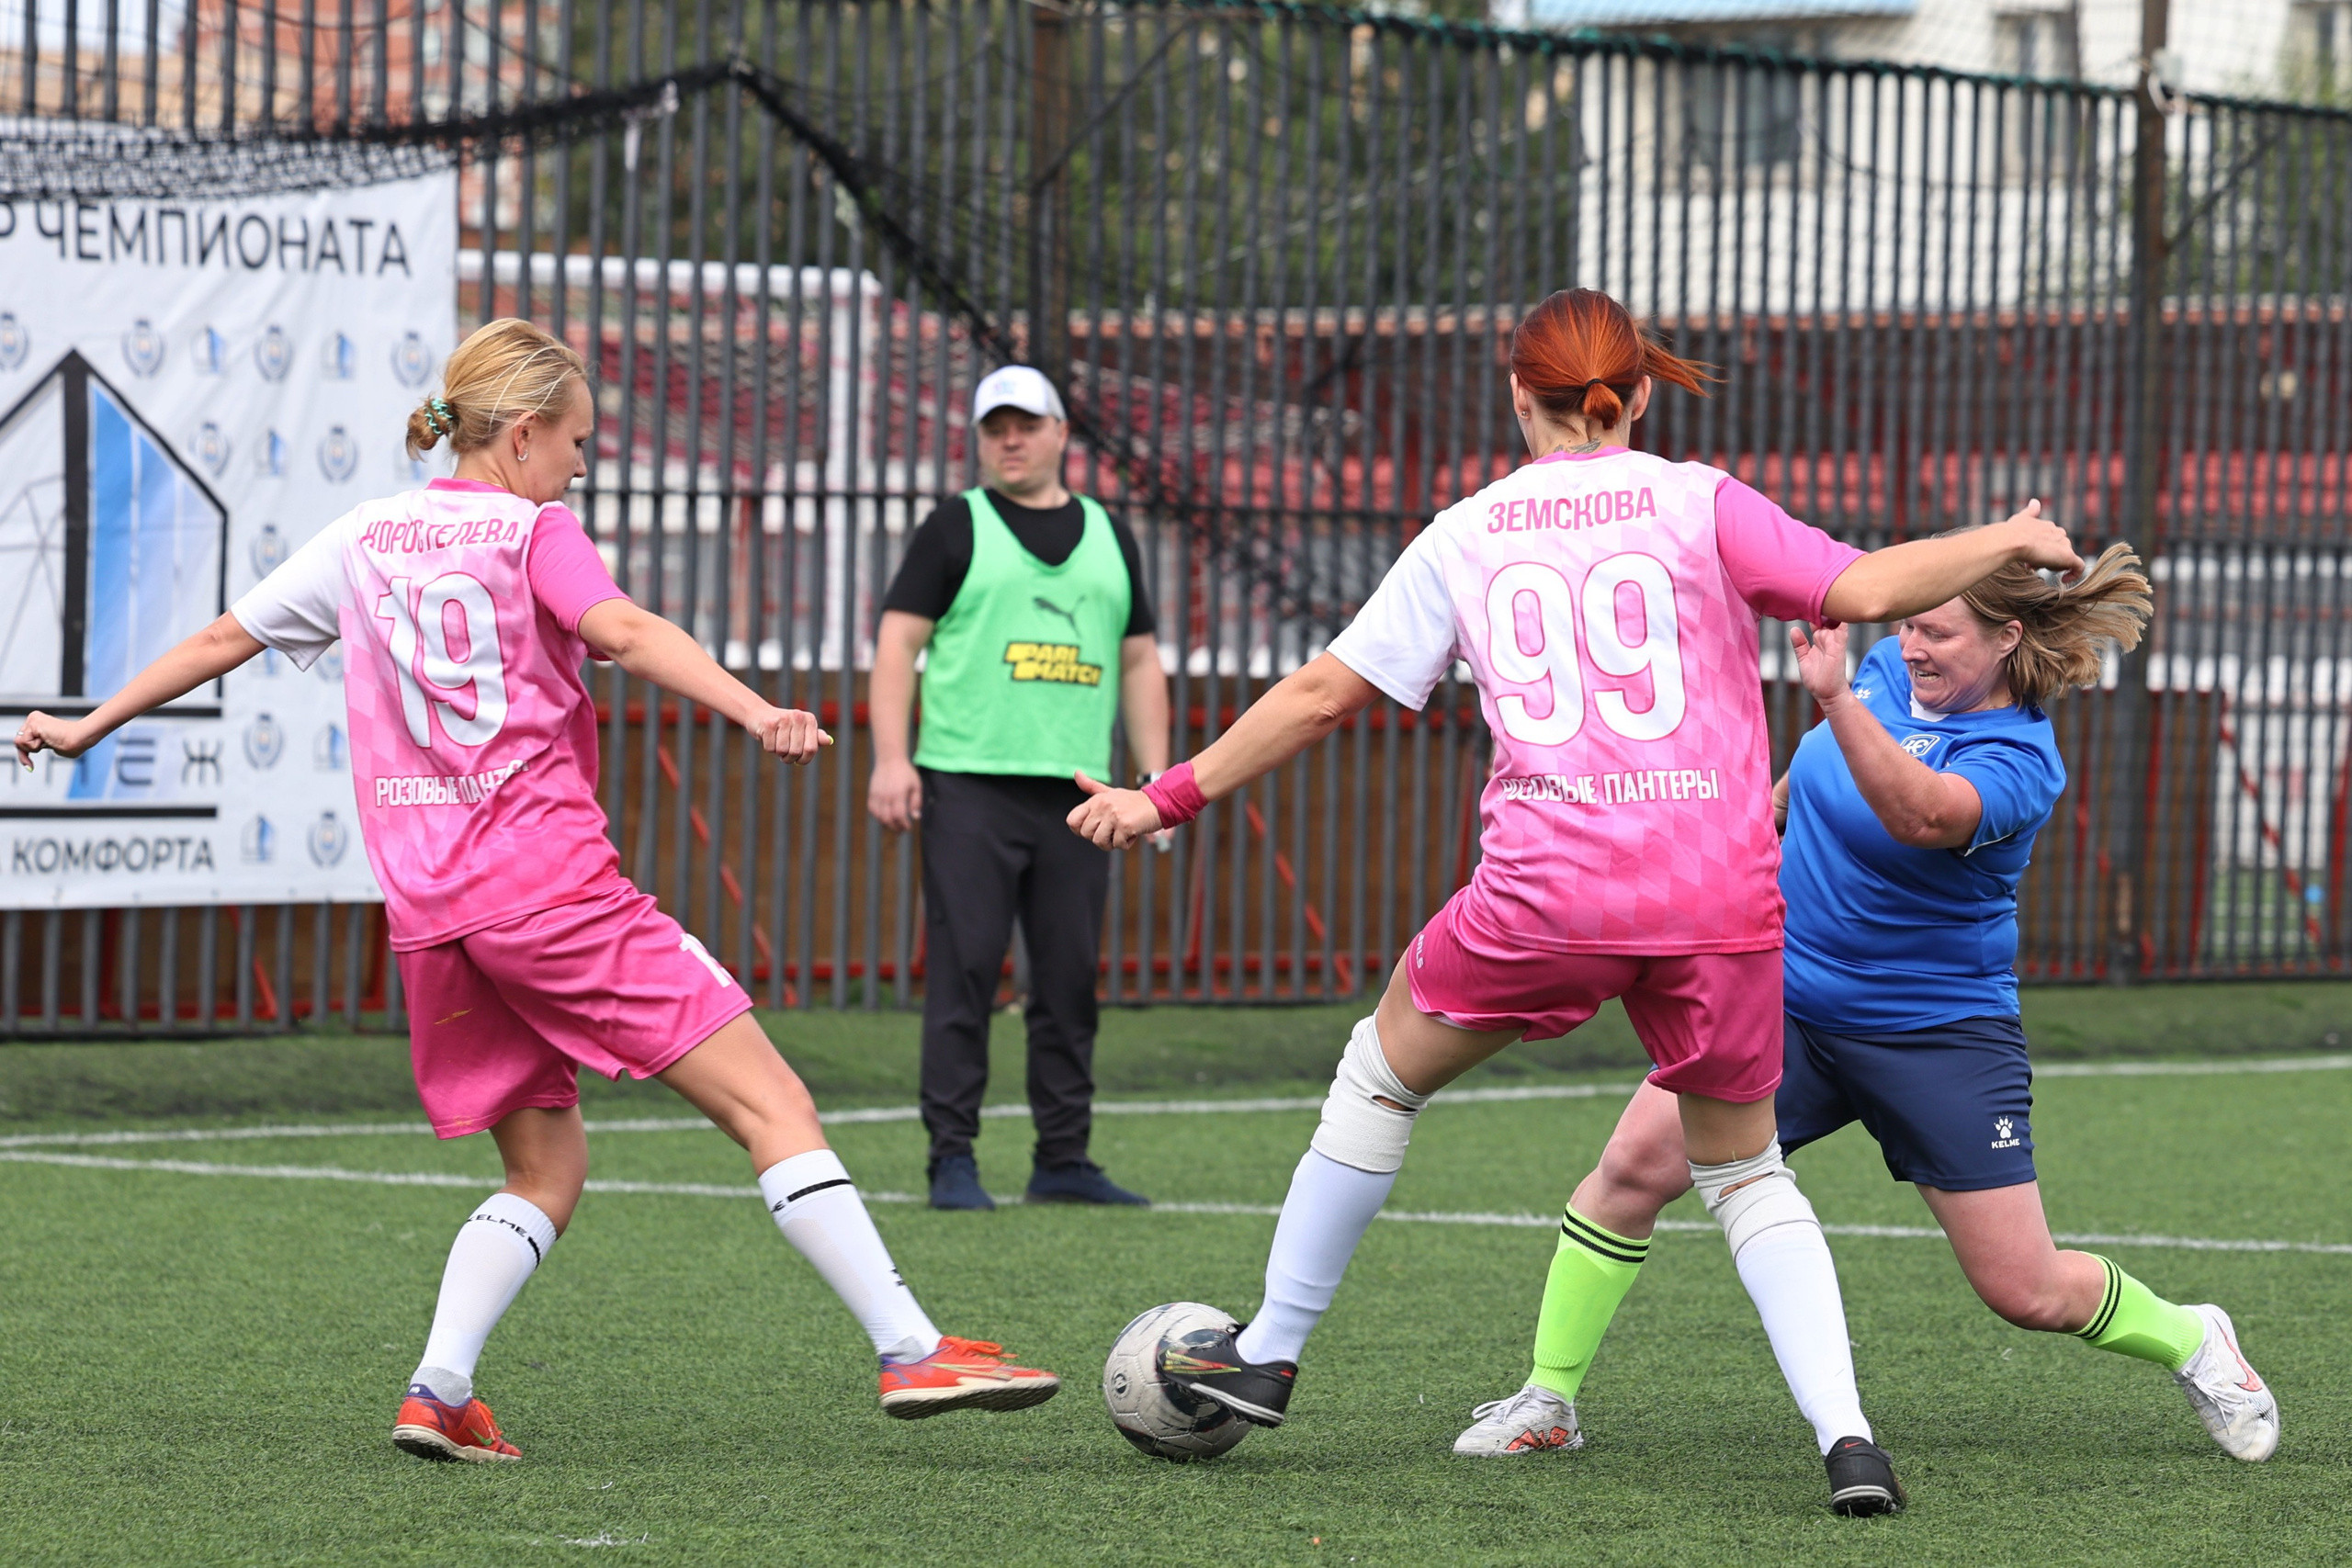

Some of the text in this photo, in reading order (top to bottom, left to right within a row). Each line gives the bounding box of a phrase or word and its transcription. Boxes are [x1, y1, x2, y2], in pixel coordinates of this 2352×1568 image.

[35, 199, 413, 277] ЧЕМПИОНАТА
[1487, 487, 1657, 534] ЗЕМСКОВА
[374, 570, 509, 749] 19
[1485, 551, 1687, 748] 99
[375, 776, 460, 807] РОЗОВЫЕ
[1602, 768, 1721, 805] ПАНТЕРЫ
[11, 836, 217, 874] КОМФОРТА
[1991, 1138, 2020, 1149] KELME
